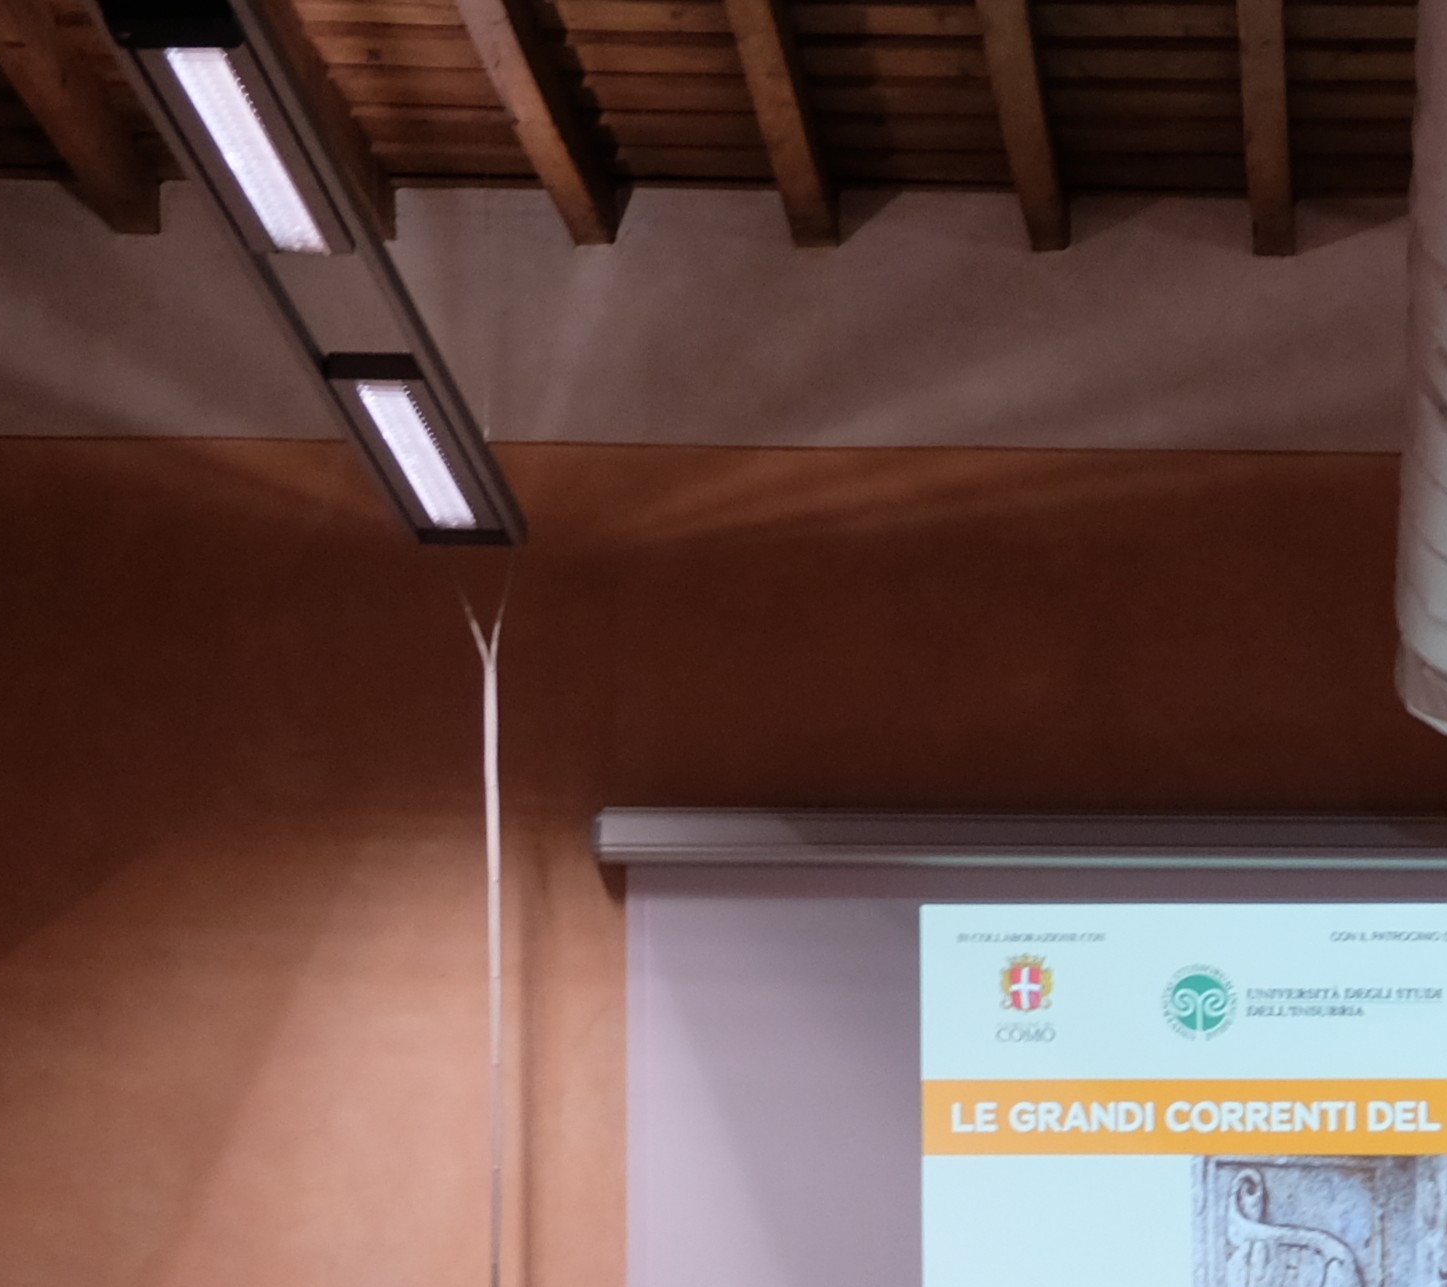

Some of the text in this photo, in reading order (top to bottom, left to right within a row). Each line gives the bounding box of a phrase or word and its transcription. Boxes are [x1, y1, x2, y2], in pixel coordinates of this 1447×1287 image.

[1246, 985, 1442, 1000] UNIVERSITÀ DEGLI STUDI
[995, 1027, 1056, 1042] COMO
[952, 1102, 997, 1134] LE
[1009, 1102, 1153, 1134] GRANDI
[1165, 1102, 1355, 1134] CORRENTI
[1367, 1102, 1440, 1134] DEL
